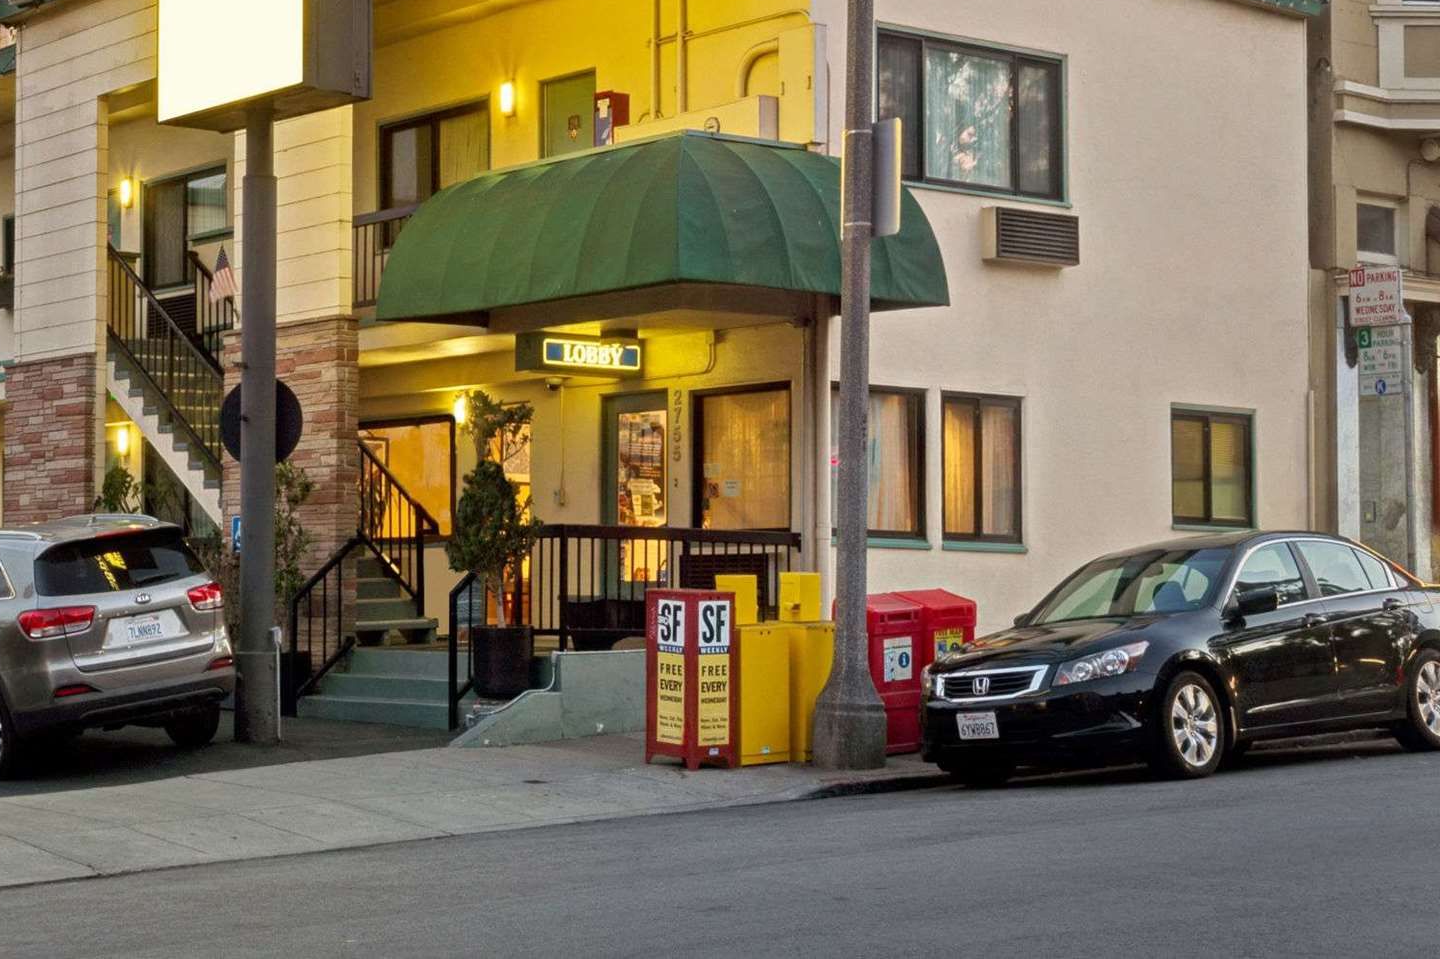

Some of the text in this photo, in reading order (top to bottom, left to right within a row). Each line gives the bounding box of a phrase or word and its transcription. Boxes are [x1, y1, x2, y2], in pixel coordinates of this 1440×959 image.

[1350, 270, 1397, 286] NO PARKING
[1356, 304, 1395, 315] WEDNESDAY
[1360, 330, 1369, 346] 3
[563, 343, 624, 367] LOBBY
[661, 603, 682, 642] SF
[702, 604, 726, 643] SF
[701, 646, 728, 654] WEEKLY
[660, 663, 682, 676] FREE
[701, 664, 727, 677] FREE
[660, 679, 682, 692] EVERY
[701, 681, 727, 693] EVERY
